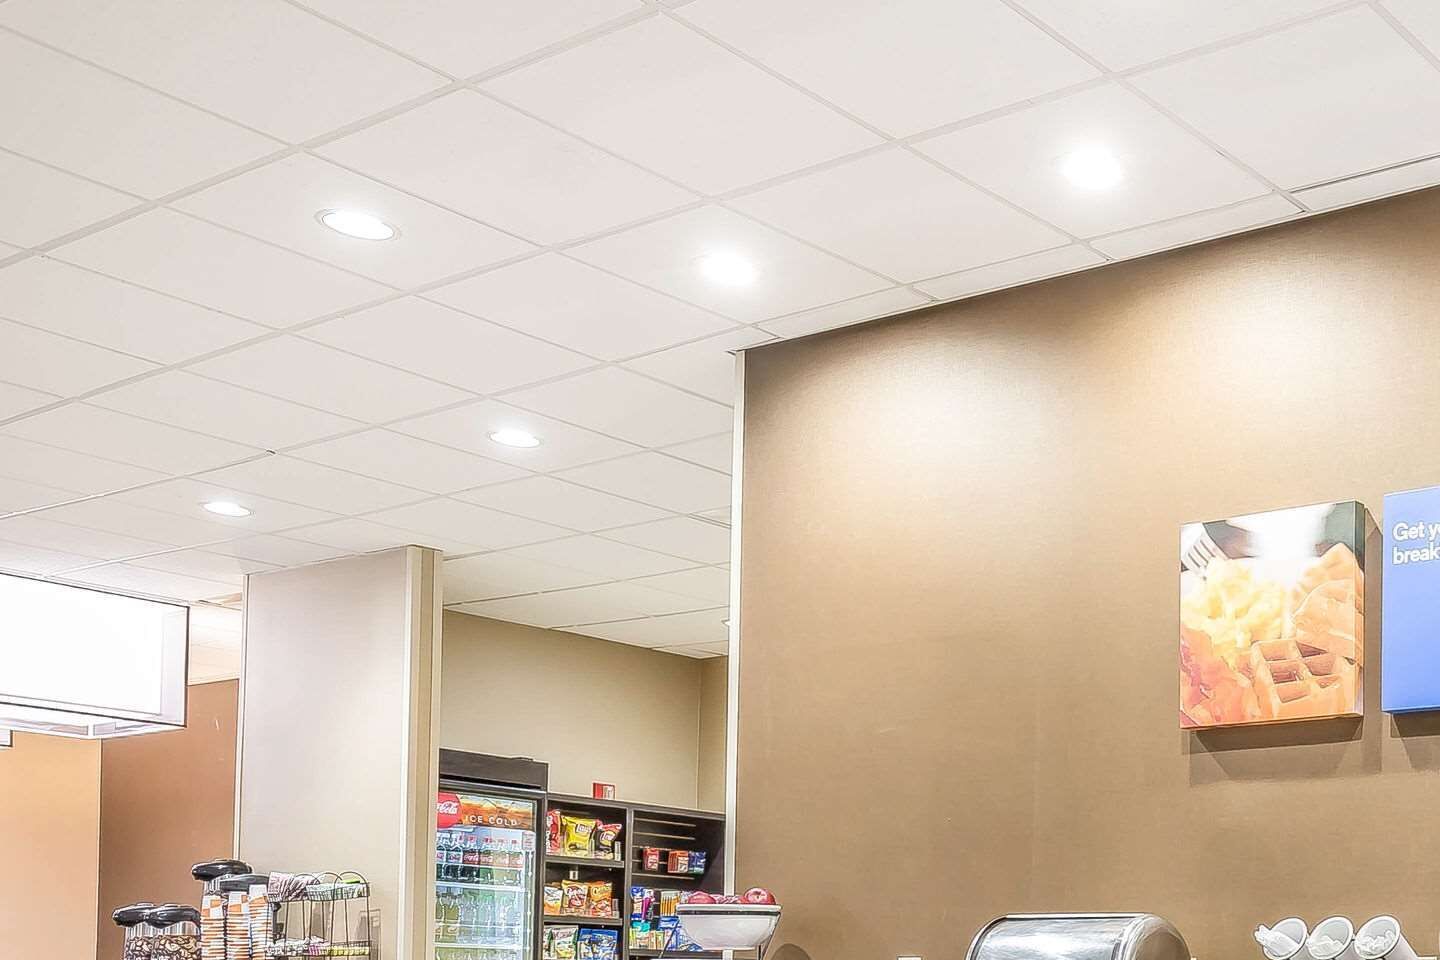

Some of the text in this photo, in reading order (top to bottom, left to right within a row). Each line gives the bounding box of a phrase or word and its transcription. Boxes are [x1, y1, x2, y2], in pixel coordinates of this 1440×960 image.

[1392, 521, 1426, 541] Get
[465, 815, 518, 826] ICE COLD
